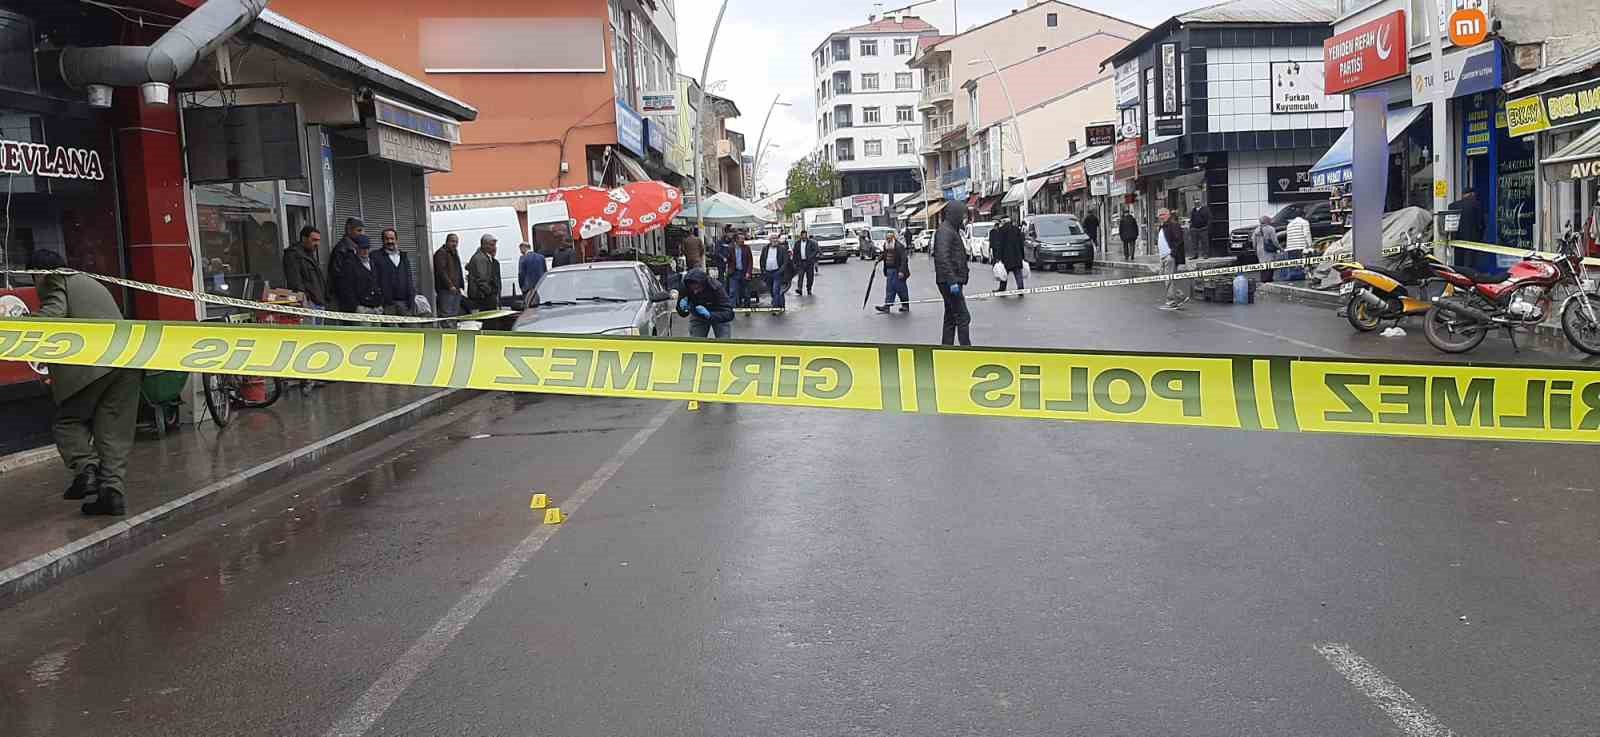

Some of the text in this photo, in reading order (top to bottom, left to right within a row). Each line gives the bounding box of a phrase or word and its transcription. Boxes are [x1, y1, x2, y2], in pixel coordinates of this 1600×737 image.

[1354, 31, 1375, 53] REFAH
[1285, 93, 1310, 102] Furkan
[1275, 102, 1319, 113] Kuyumculuk
